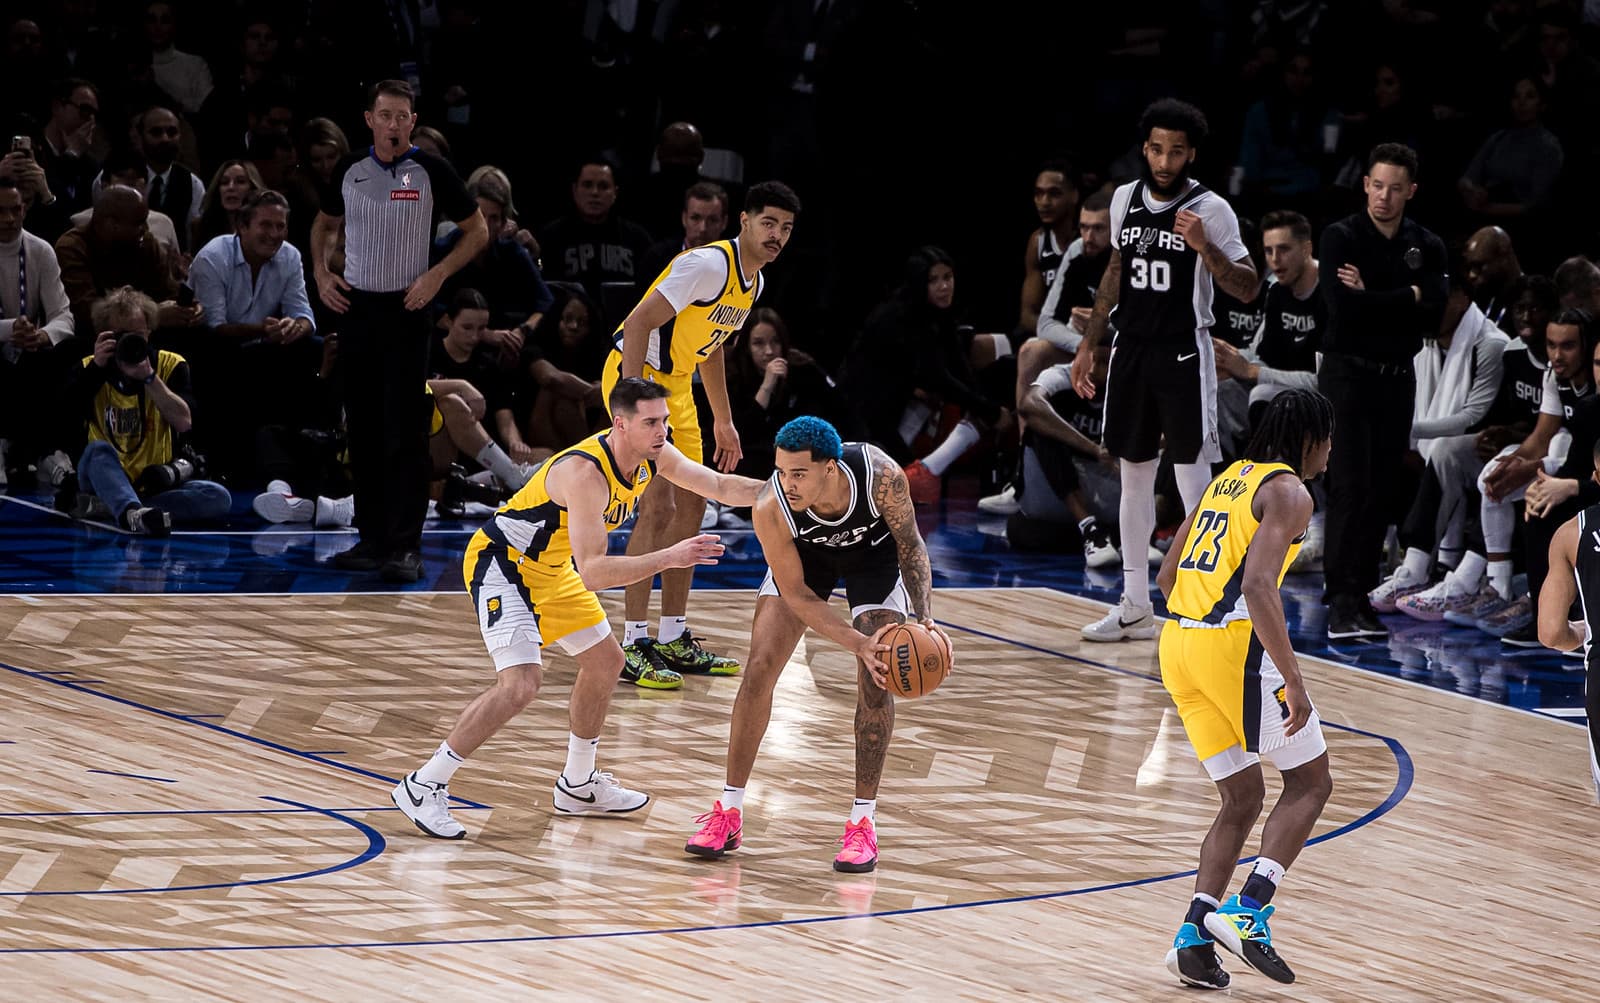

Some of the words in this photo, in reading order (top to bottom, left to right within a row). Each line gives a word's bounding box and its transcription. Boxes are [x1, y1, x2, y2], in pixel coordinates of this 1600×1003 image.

[391, 191, 419, 199] Emirates
[1121, 226, 1185, 252] SPURS
[1131, 257, 1170, 291] 30
[1515, 379, 1542, 405] SPU
[1179, 509, 1229, 573] 23
[897, 643, 912, 692] Wilson
